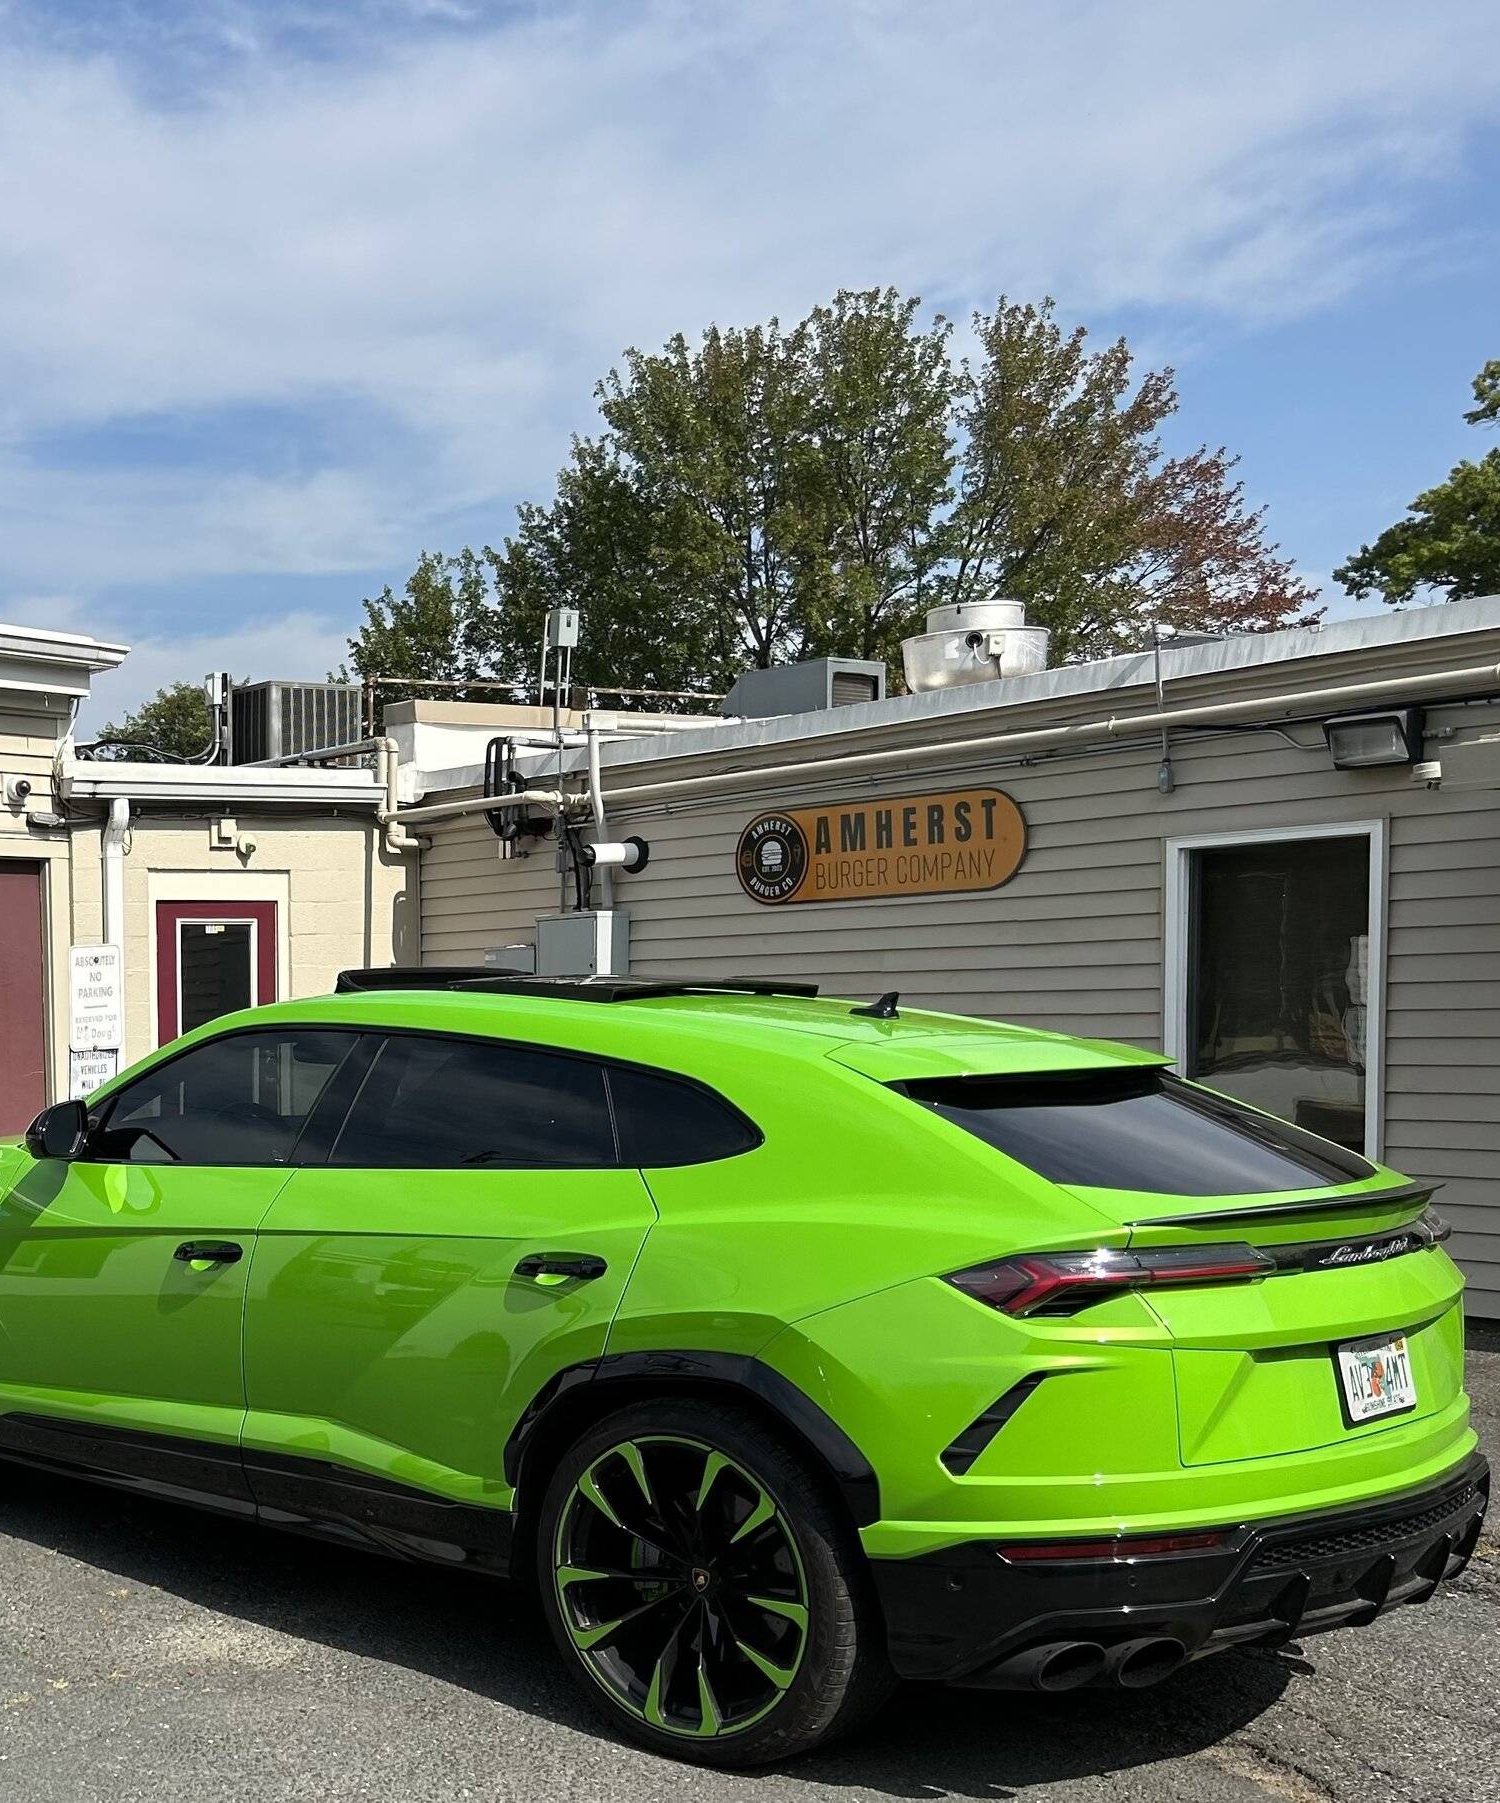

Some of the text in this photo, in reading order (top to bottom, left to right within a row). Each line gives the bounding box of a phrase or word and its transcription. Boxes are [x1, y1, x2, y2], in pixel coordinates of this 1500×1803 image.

[751, 820, 792, 839] AMHERST
[815, 798, 997, 855] AMHERST
[815, 848, 996, 890] BURGER COMPANY
[750, 877, 781, 896] BURGER
[75, 955, 116, 966] ABSOUTELY
[89, 971, 102, 983] NO
[78, 986, 113, 999] PARKING
[80, 1064, 108, 1075] VEHICLES
[81, 1079, 94, 1090] WILL
